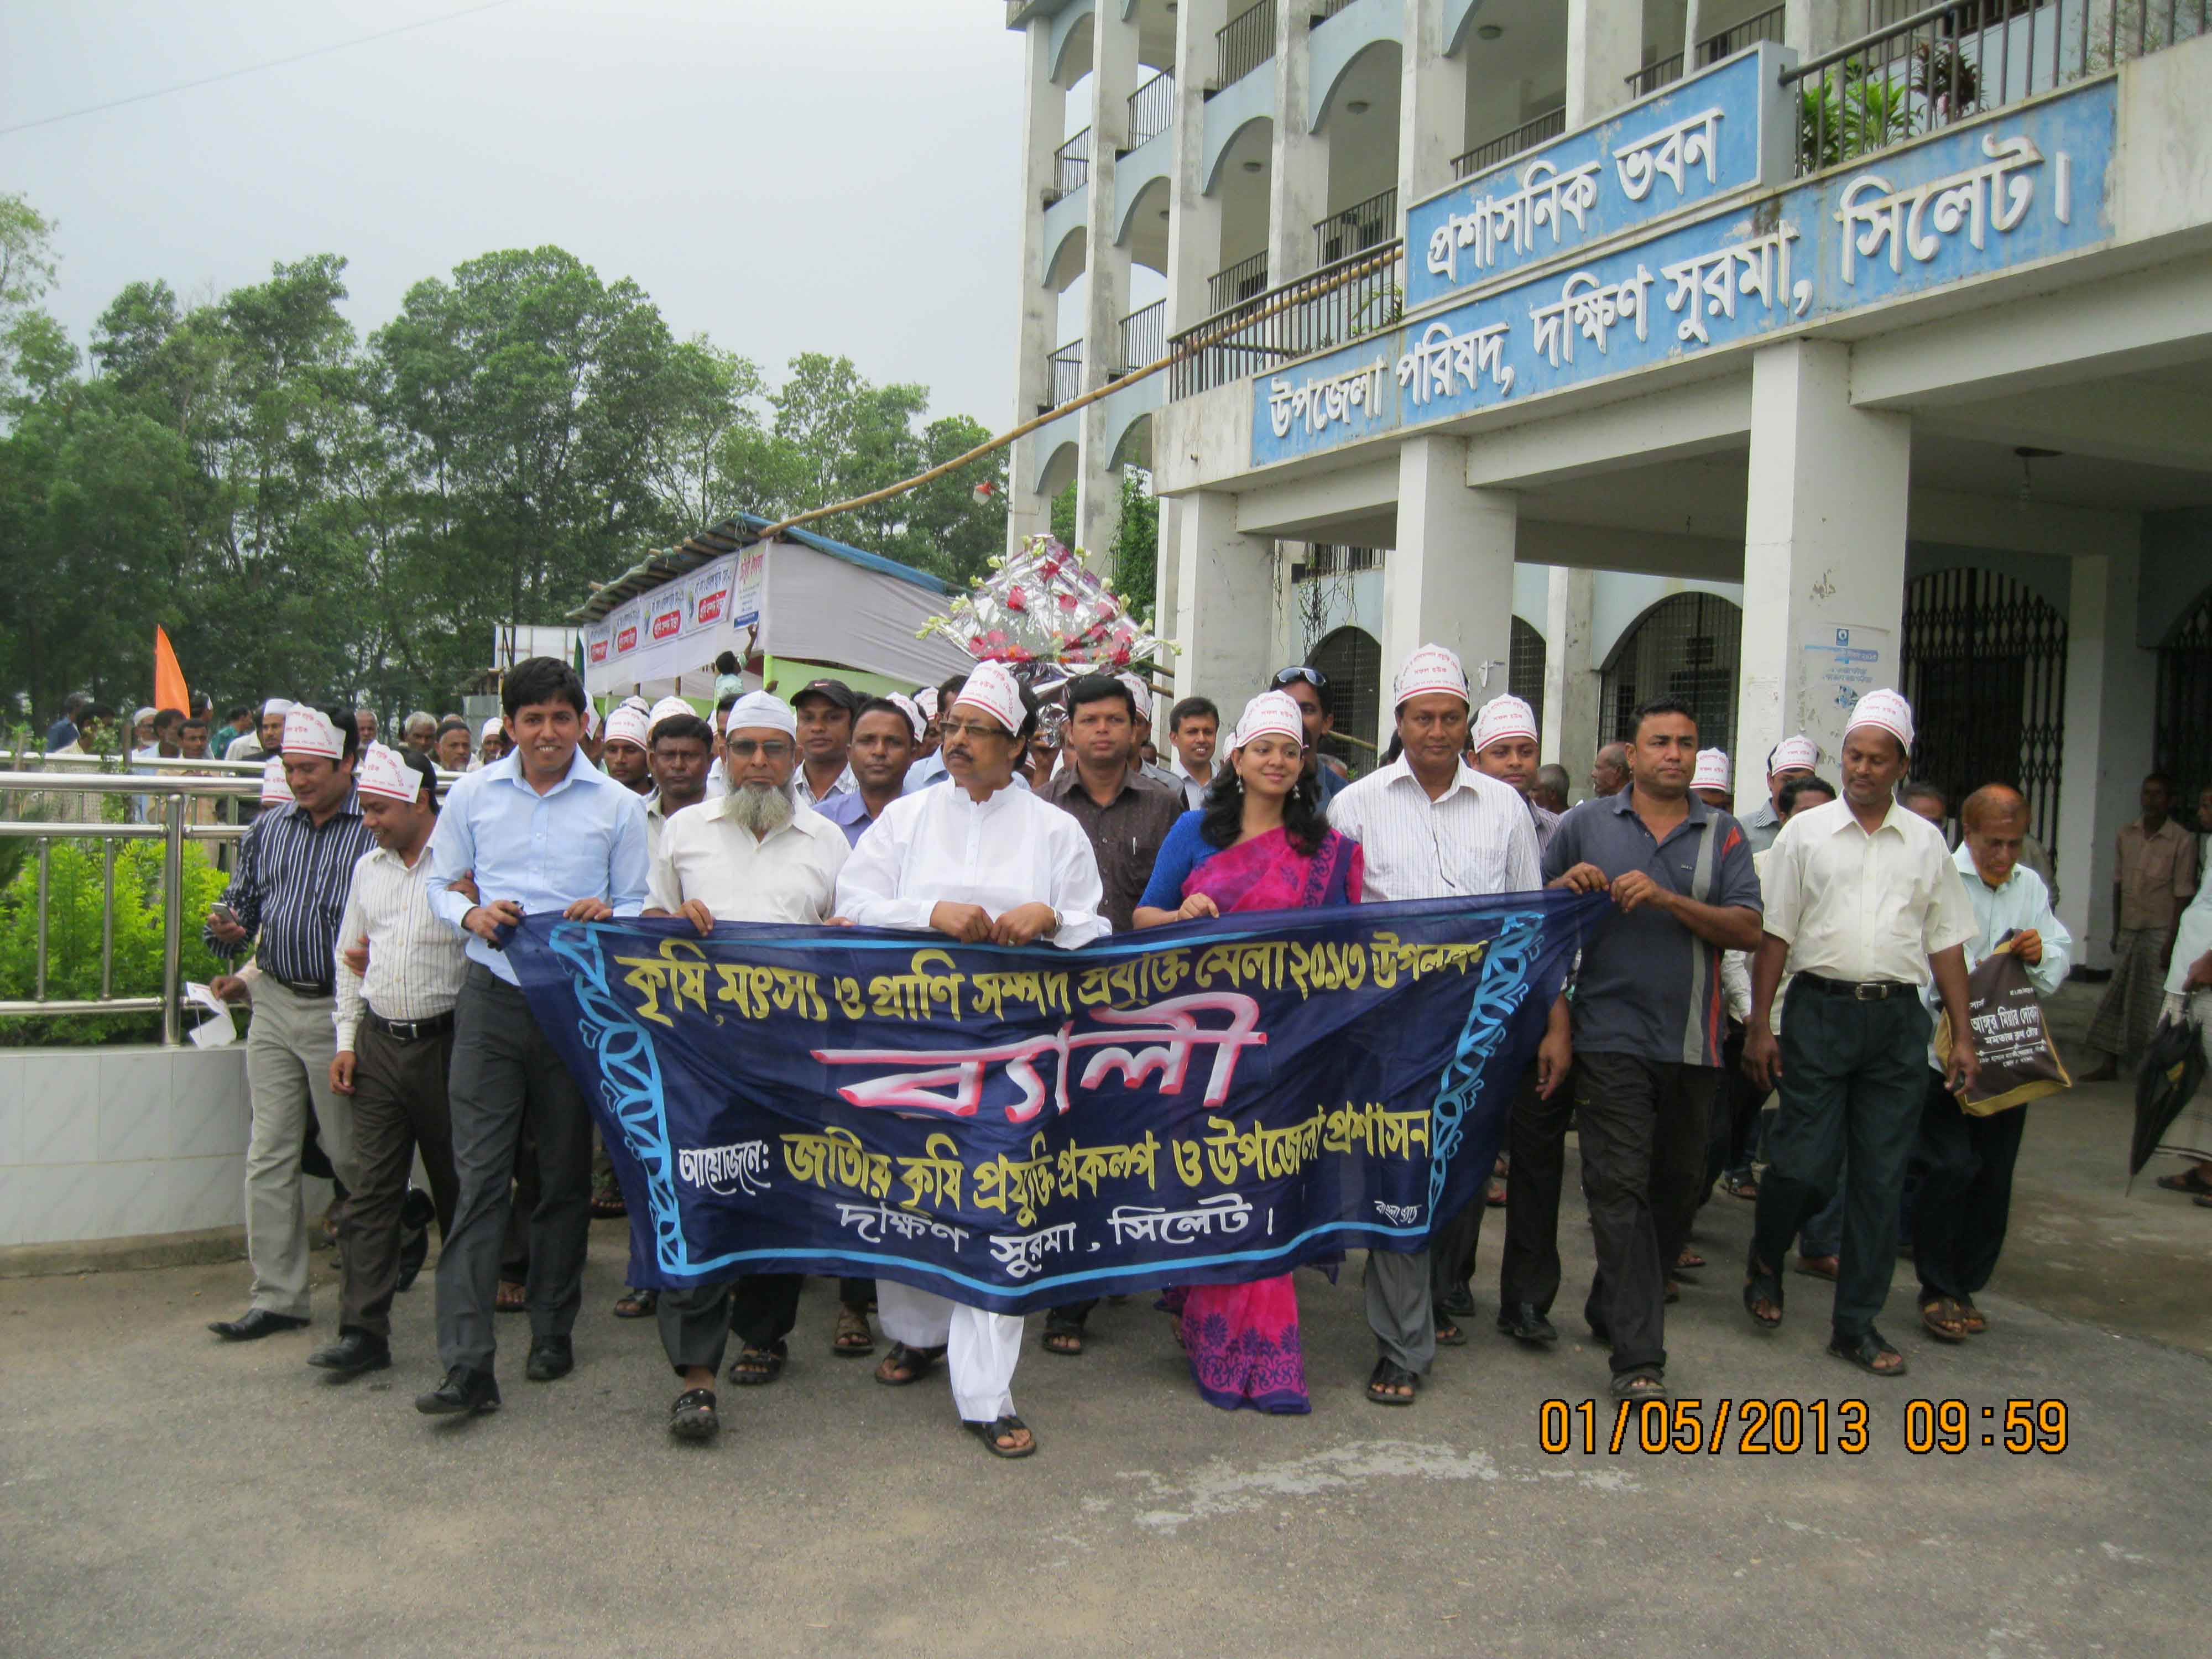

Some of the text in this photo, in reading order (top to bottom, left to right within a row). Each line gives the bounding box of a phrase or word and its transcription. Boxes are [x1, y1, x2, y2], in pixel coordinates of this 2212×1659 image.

[1427, 108, 1724, 283] প্রশাসনিক ভবন
[1269, 354, 1389, 437] উপজেলা
[1530, 264, 1654, 368] দক্ষিণ
[834, 975, 866, 1020] ও
[972, 972, 1071, 1021] সম্পদ
[1195, 942, 1287, 990] মেলা
[1290, 941, 1366, 1000] ২০১৩
[896, 1133, 964, 1217] কৃষি
[973, 1130, 1055, 1228] প্রযুক্তি
[1057, 1129, 1161, 1200] প্রকল্প
[1172, 1139, 1203, 1187] ও
[1203, 1104, 1326, 1185] উপজেলা
[1323, 1100, 1431, 1160] প্রশাসন
